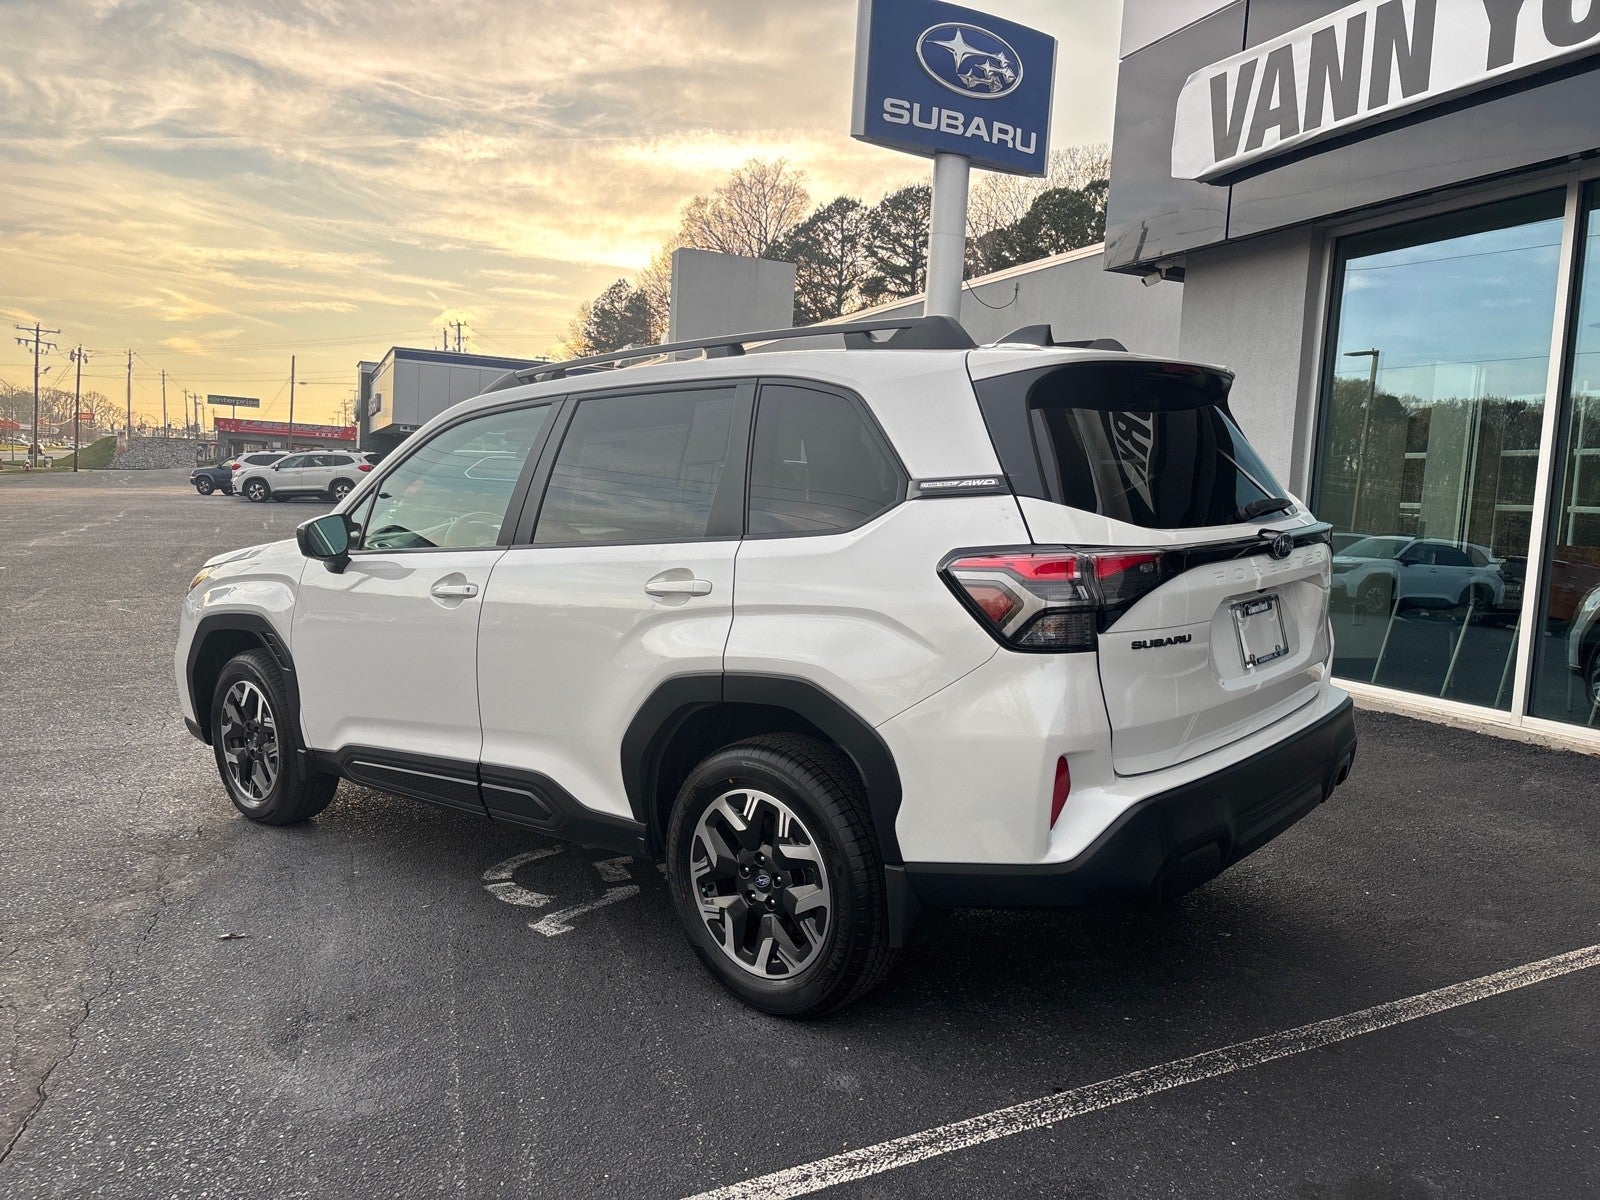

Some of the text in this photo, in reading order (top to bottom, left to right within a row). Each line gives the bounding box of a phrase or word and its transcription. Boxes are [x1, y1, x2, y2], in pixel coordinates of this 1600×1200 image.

[1209, 0, 1437, 164] VANN
[882, 97, 1037, 155] SUBARU
[958, 479, 996, 487] AWD
[1213, 550, 1324, 585] FORESTER
[1131, 634, 1192, 650] SUBARU
